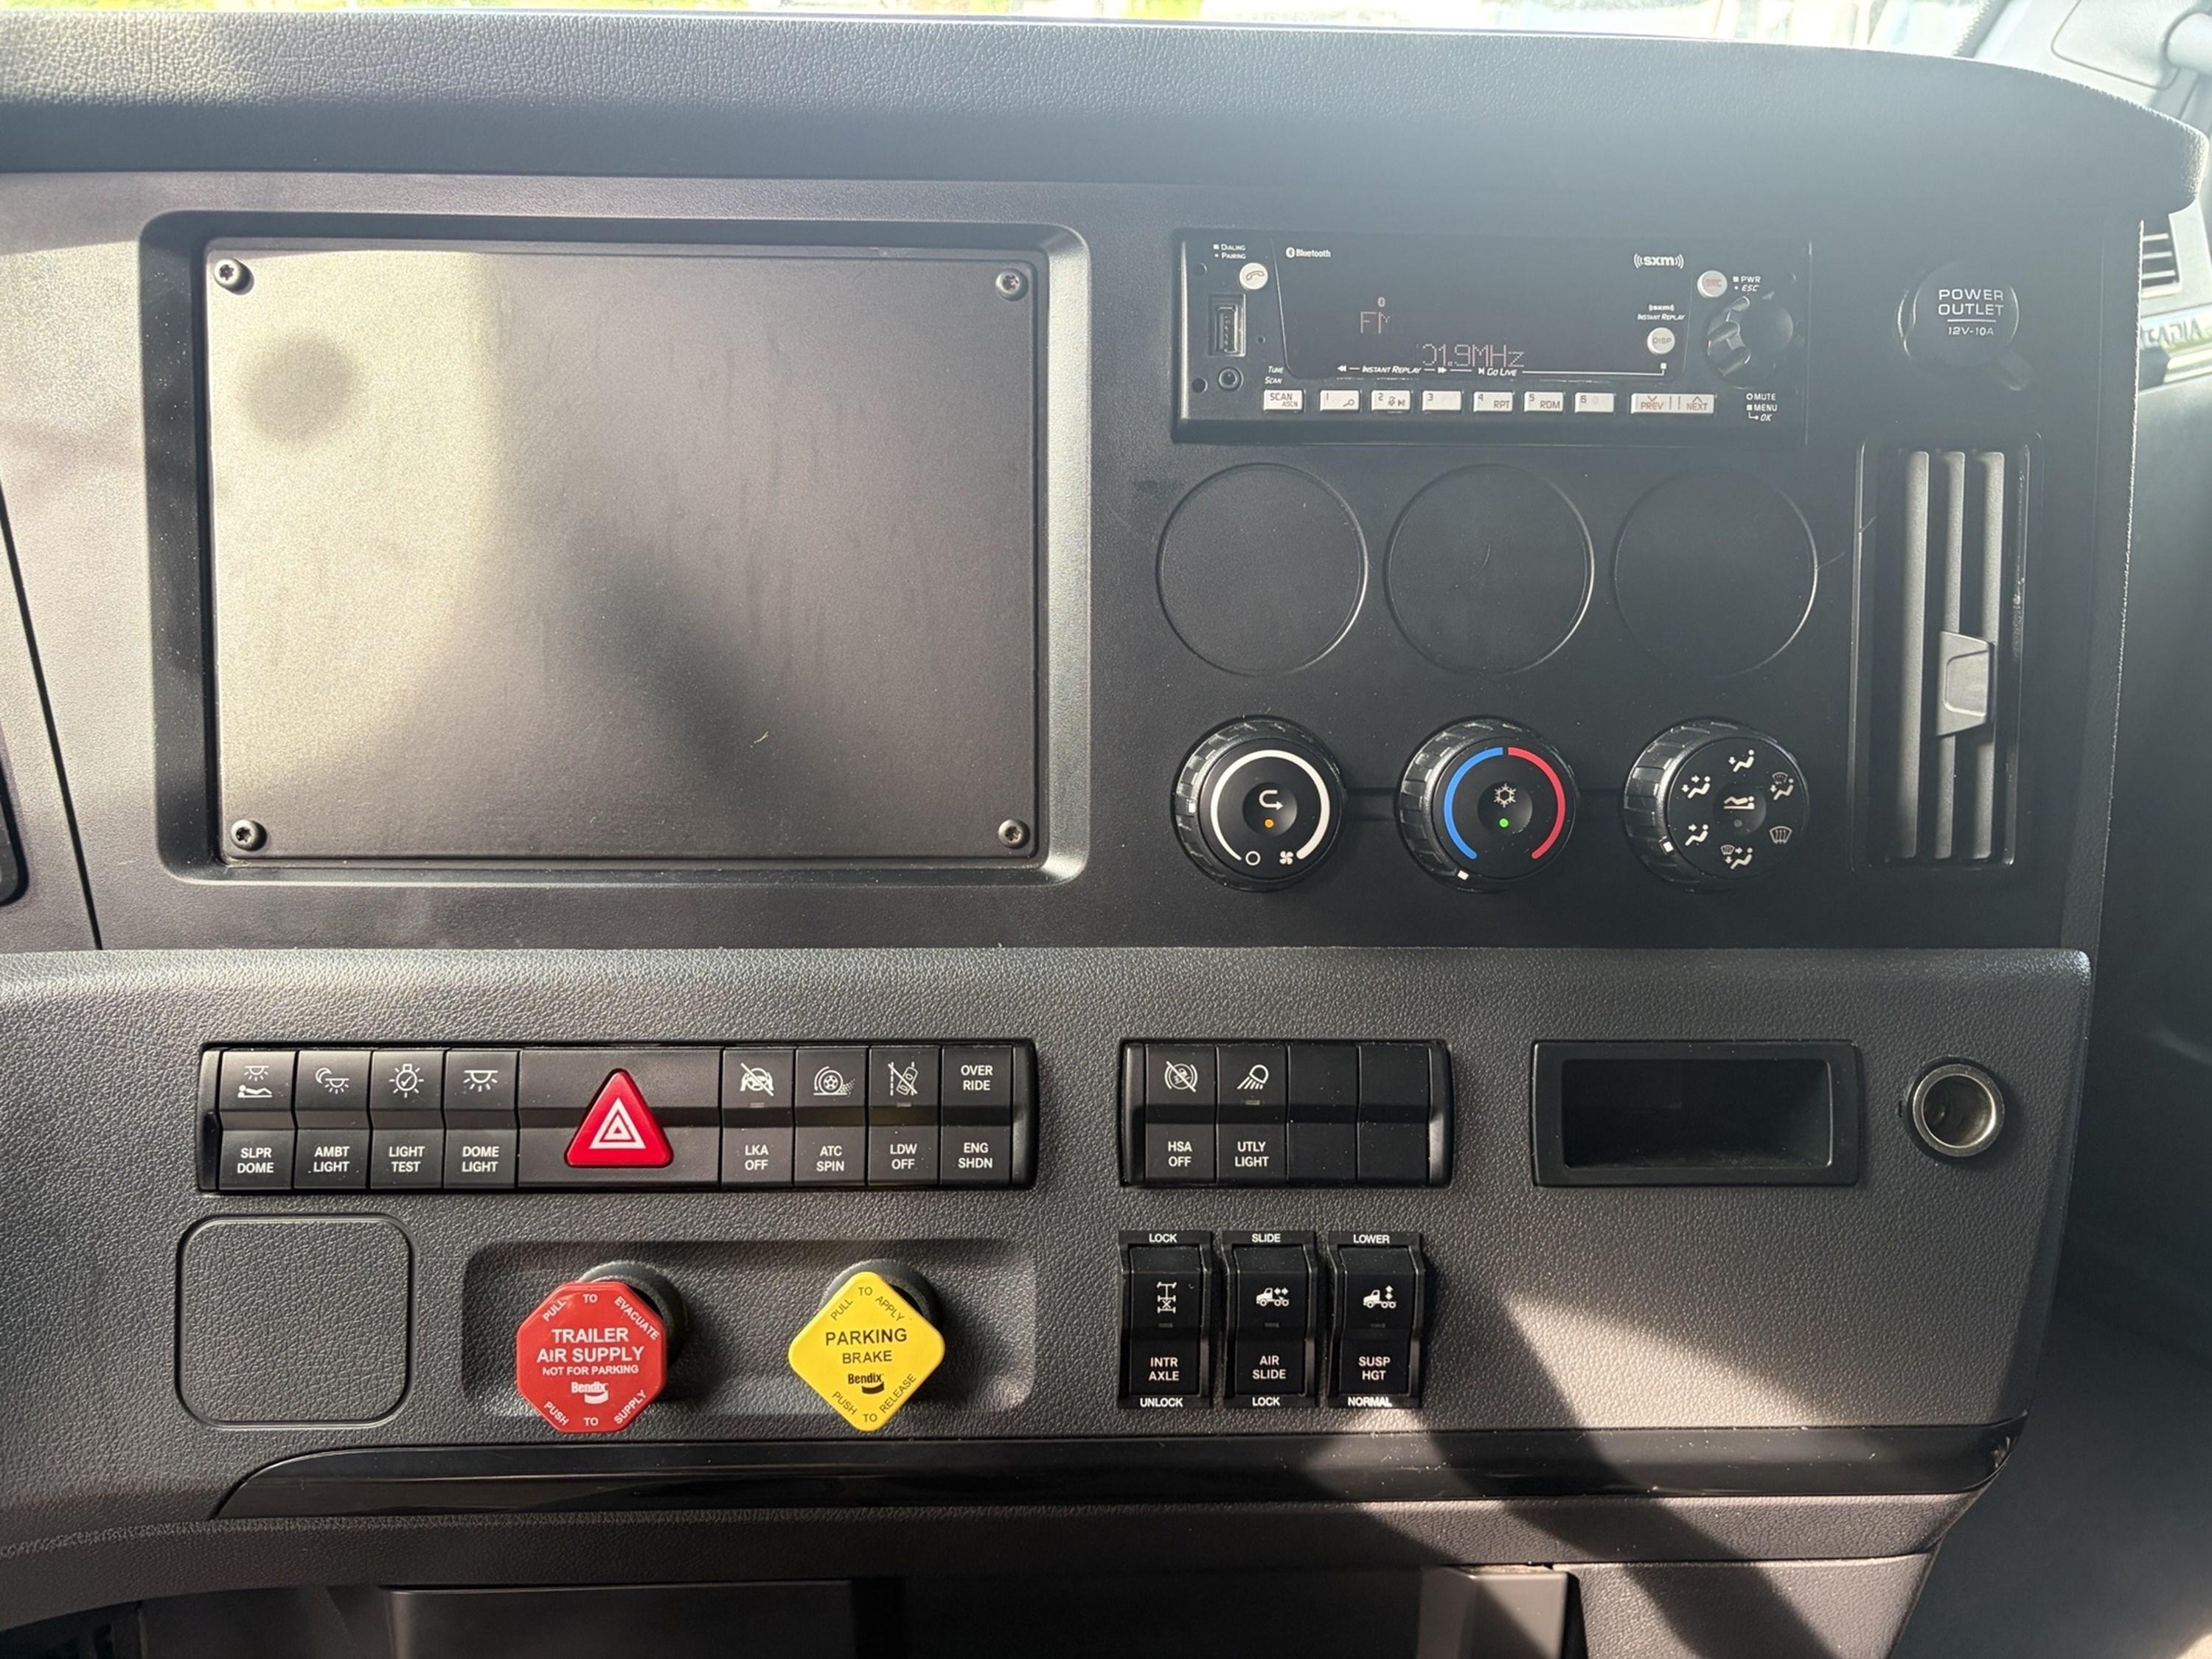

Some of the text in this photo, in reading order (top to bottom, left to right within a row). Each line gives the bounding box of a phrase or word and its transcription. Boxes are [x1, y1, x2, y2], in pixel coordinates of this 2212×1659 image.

[1295, 248, 1331, 258] Bluetooth
[1705, 278, 1722, 288] SRC
[1741, 275, 1761, 283] PWR
[1742, 284, 1760, 292] ESC
[1938, 288, 2004, 302] POWER
[1938, 304, 2004, 316] OUTLET
[1947, 327, 1994, 336] 12V-10A
[1270, 392, 1293, 401] SCAN
[1377, 393, 1383, 401] 2
[1427, 393, 1433, 401] 3
[1529, 394, 1535, 403] 5
[1580, 395, 1586, 403] 6
[1753, 392, 1776, 401] MUTE
[1494, 400, 1510, 408] RPT
[1540, 400, 1560, 409] RDM
[1641, 401, 1663, 411] PREV
[1686, 402, 1708, 411] NEXT
[1753, 403, 1778, 412] MENU
[1760, 413, 1773, 422] OK
[961, 1065, 993, 1077] OVER
[963, 1079, 991, 1091] RIDE
[314, 1146, 349, 1158] AMBT
[389, 1146, 425, 1158] LIGHT
[462, 1146, 500, 1158] DOME
[745, 1144, 769, 1155] LKA
[819, 1145, 843, 1157] ATC
[890, 1144, 917, 1155] LDW
[964, 1142, 989, 1154] ENG
[1168, 1141, 1192, 1152] HSA
[1237, 1141, 1266, 1152] UTLY
[240, 1147, 272, 1159] SLPR
[313, 1161, 349, 1172] LIGHT
[392, 1161, 420, 1172] TEST
[462, 1161, 498, 1172] LIGHT
[745, 1159, 768, 1171] OFF
[816, 1160, 844, 1172] SPIN
[891, 1158, 915, 1170] OFF
[958, 1157, 993, 1169] SHDN
[1168, 1155, 1192, 1167] OFF
[1235, 1156, 1269, 1168] LIGHT
[237, 1162, 274, 1174] DOME
[1149, 1233, 1178, 1243] LOCK
[1251, 1233, 1281, 1243] SLIDE
[1353, 1234, 1391, 1244] LOWER
[830, 1287, 905, 1321] PULL TO APPLY
[542, 1293, 660, 1340] PULL TO EVACUATE
[552, 1327, 629, 1343] TRAILER
[825, 1328, 907, 1346] PARKING
[536, 1346, 644, 1363] AIR SUPPLY
[842, 1350, 892, 1364] BRAKE
[1259, 1354, 1280, 1366] AIR
[1150, 1357, 1178, 1367] INTR
[1358, 1356, 1391, 1367] SUSP
[543, 1364, 639, 1376] NOT FOR PARKING
[1253, 1368, 1287, 1380] SLIDE
[1362, 1370, 1386, 1380] HGT
[847, 1372, 883, 1385] Bendix
[1149, 1371, 1180, 1381] AXLE
[571, 1381, 607, 1394] Bendix
[832, 1373, 917, 1422] PUSH TO RELEASE
[1140, 1397, 1183, 1408] UNLOCK
[1251, 1397, 1280, 1407] LOCK
[1347, 1397, 1392, 1407] NORMAL
[544, 1389, 647, 1426] PUSH TO SUPPLY
